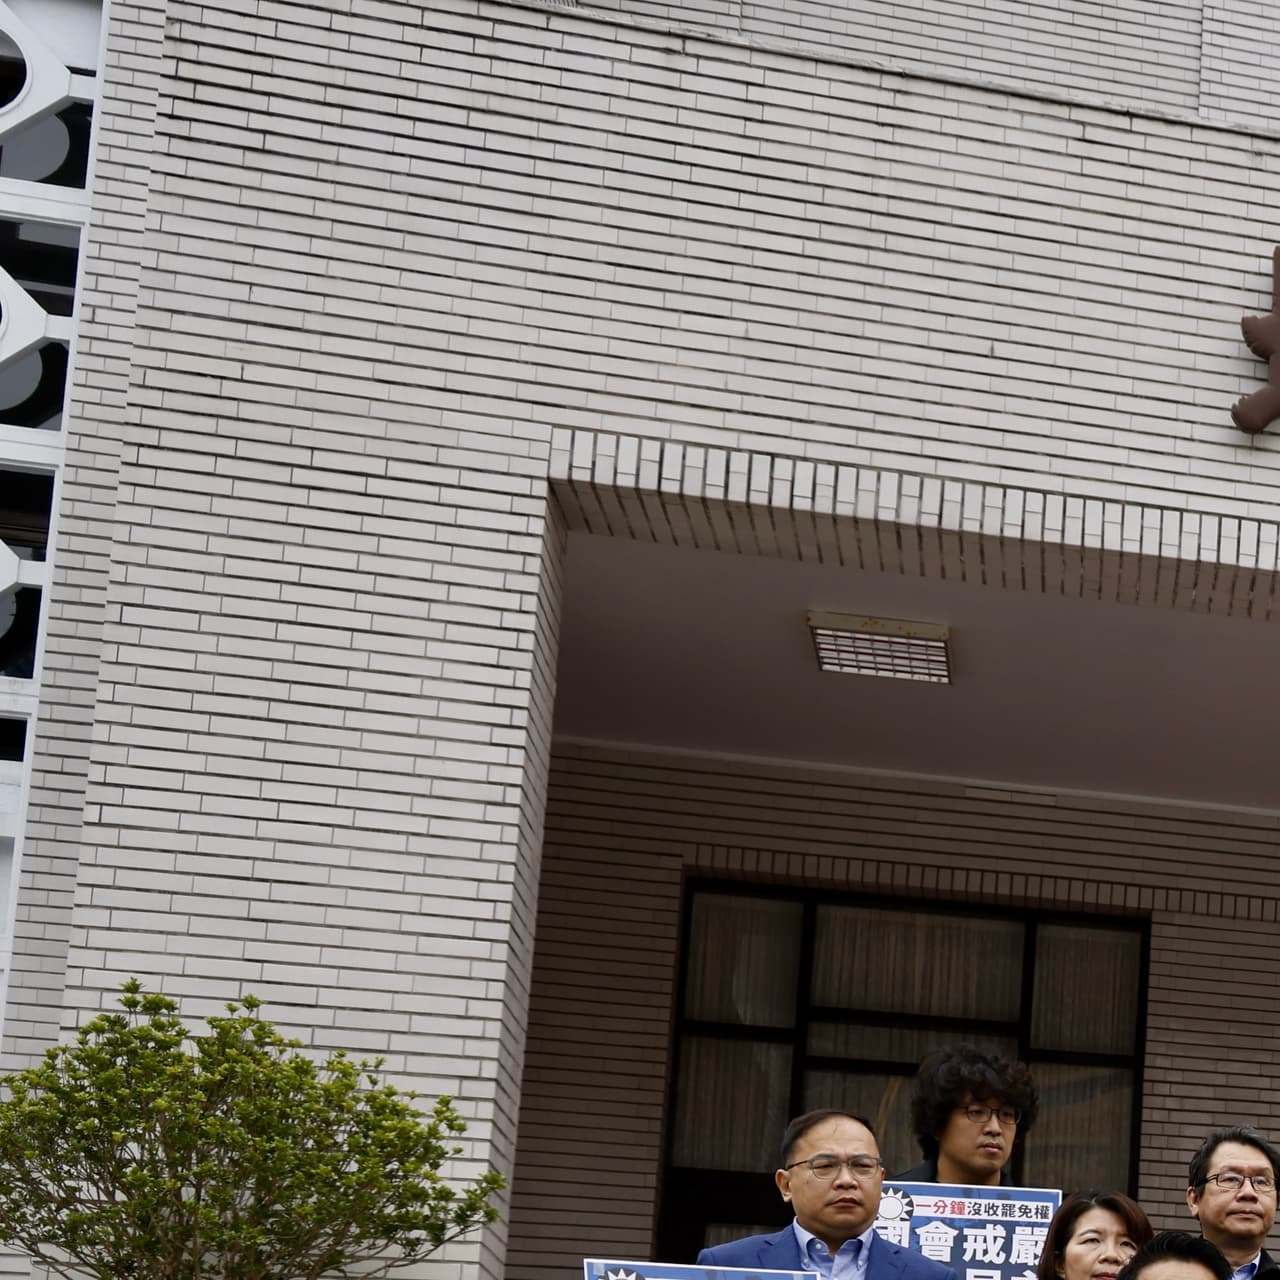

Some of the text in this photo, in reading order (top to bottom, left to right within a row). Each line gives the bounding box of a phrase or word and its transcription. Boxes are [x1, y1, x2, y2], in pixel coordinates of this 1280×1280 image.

[916, 1200, 1050, 1220] 一分鐘沒收罷免權
